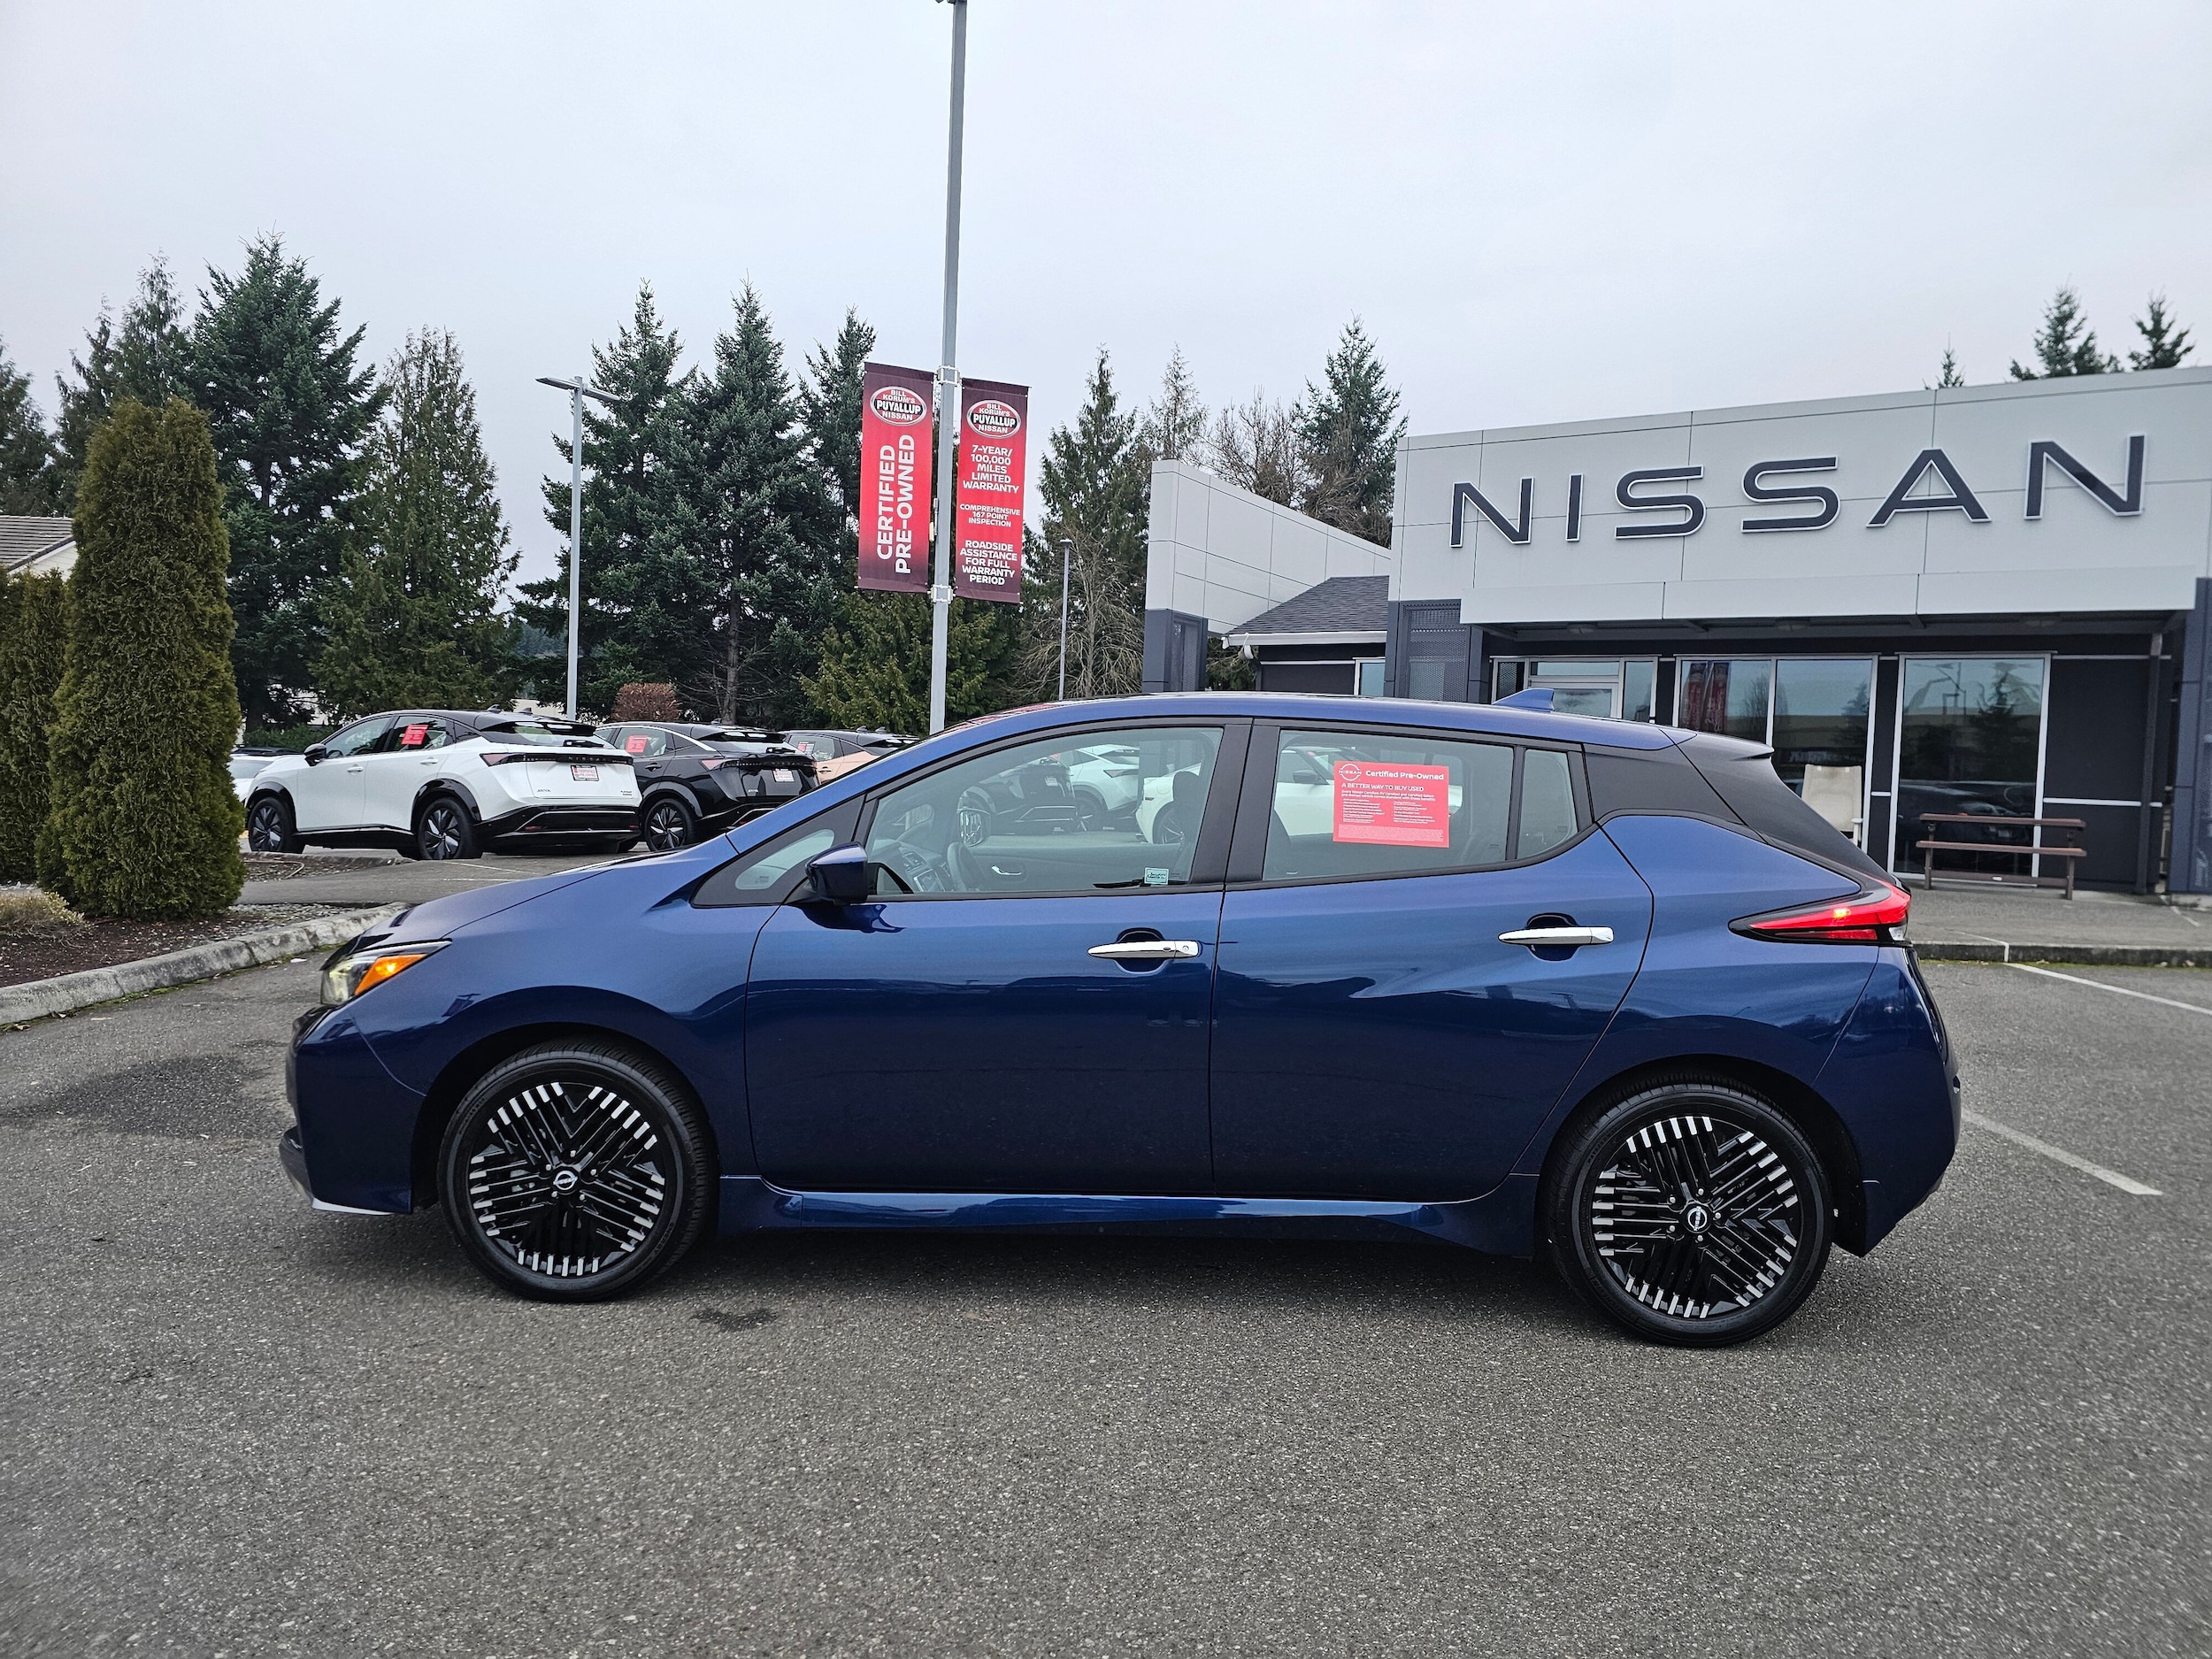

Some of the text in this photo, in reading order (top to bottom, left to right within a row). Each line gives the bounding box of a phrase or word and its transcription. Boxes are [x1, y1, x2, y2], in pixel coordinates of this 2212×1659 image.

[882, 395, 915, 403] KORUM'S
[876, 400, 921, 414] PUYALLUP
[979, 408, 1010, 417] KORUM'S
[882, 411, 913, 421] NISSAN
[973, 413, 1015, 426] PUYALLUP
[979, 425, 1008, 434] NISSAN
[972, 444, 1014, 458] 7-YEAR/
[971, 454, 1011, 467] 100,000
[977, 463, 1008, 474] MILES
[972, 472, 1012, 484] LIMITED
[962, 480, 1020, 495] WARRANTY
[1450, 434, 2145, 548] NISSAN
[877, 445, 895, 560] CERTIFIED
[895, 434, 915, 573] PRE-OWNED
[958, 503, 1022, 516] COMPREHENSIVE
[967, 517, 1011, 528] INSPECTION
[987, 512, 1010, 521] POINT
[964, 540, 1014, 553] ROADSIDE
[959, 548, 1018, 562] ASSISTANCE
[965, 557, 1010, 570] FOR FULL
[962, 565, 1017, 579] WARRANTY
[969, 574, 1006, 586] PERIOD
[1365, 770, 1445, 780] Certified Pre-Owned
